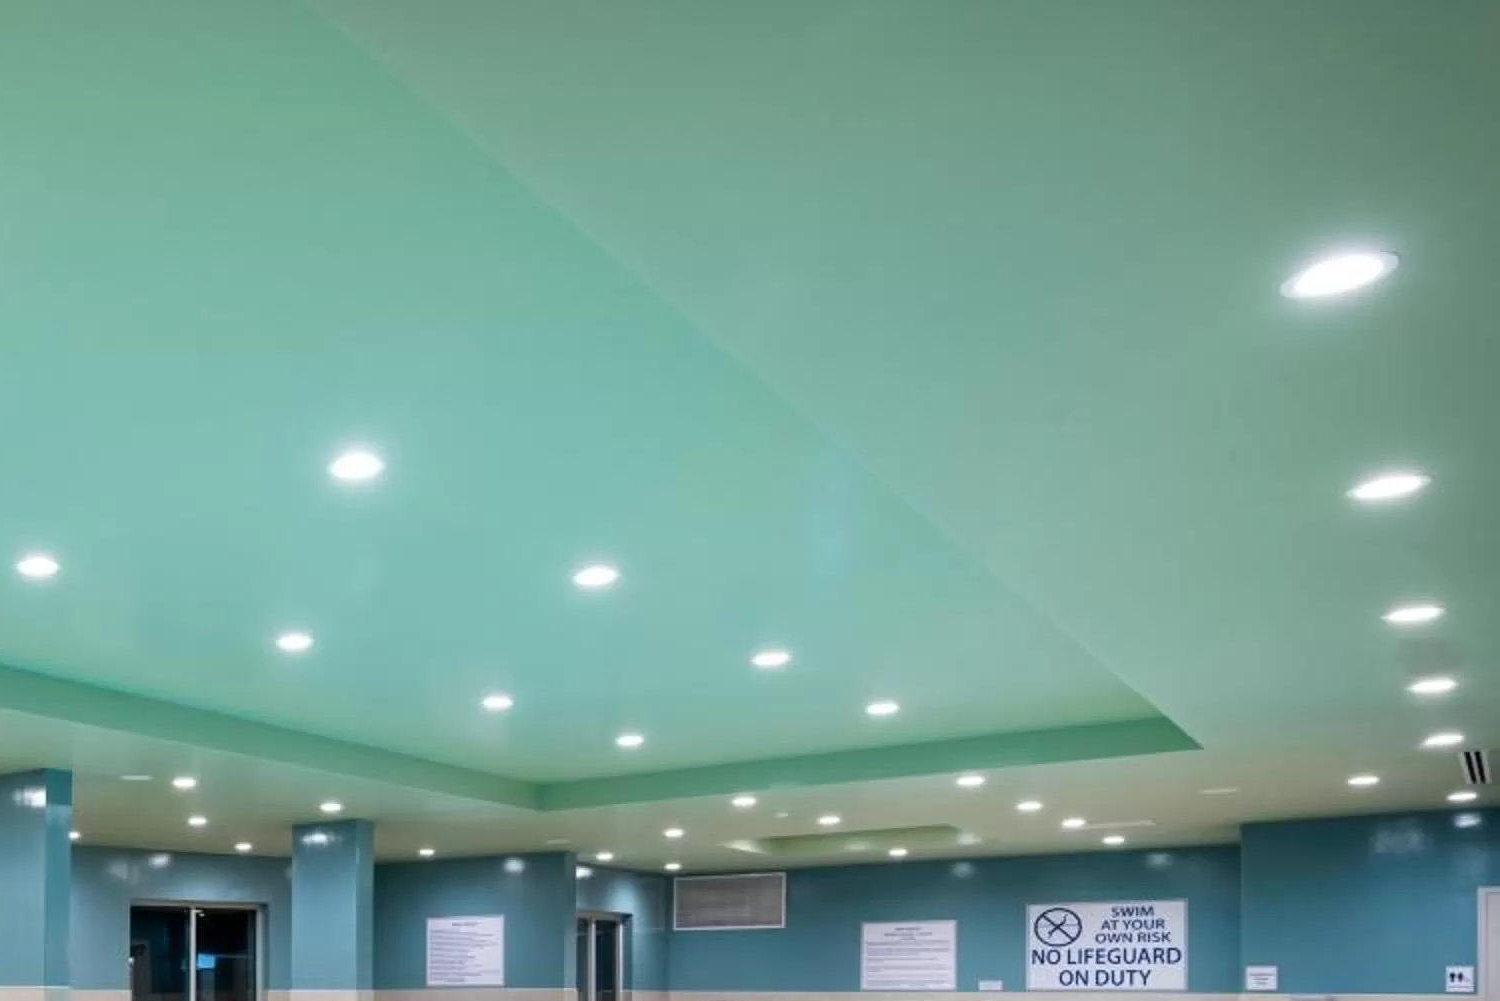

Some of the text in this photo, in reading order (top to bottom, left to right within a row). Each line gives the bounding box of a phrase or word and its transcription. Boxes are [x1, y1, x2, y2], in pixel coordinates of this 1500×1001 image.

[1111, 906, 1155, 918] SWIM
[1101, 918, 1165, 931] AT YOUR
[1095, 931, 1171, 943] OWN RISK
[1031, 947, 1182, 965] NO LIFEGUARD
[1059, 969, 1151, 986] ON DUTY
